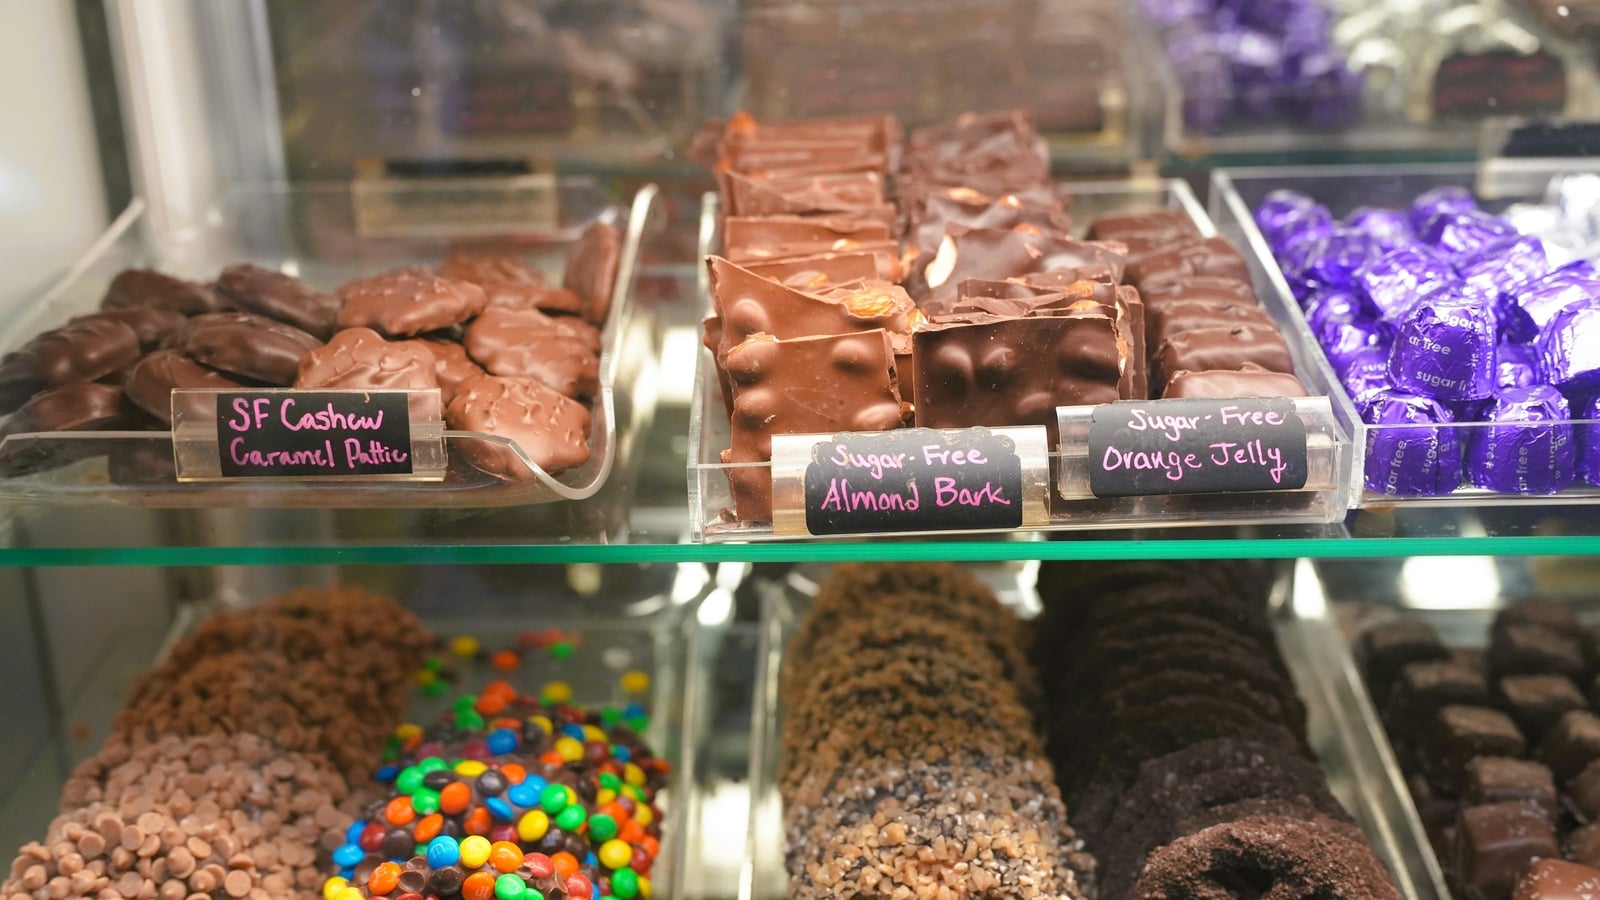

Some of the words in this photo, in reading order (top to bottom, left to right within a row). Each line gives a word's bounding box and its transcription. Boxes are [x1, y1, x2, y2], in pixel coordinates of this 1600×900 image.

[1416, 371, 1457, 389] sugar
[228, 397, 271, 432] SF
[280, 398, 384, 432] Cashew
[229, 436, 336, 468] Caramel
[1102, 445, 1202, 481] Orange
[1208, 439, 1288, 484] Jelly
[1390, 440, 1408, 468] free
[1516, 446, 1528, 474] free
[820, 478, 920, 513] Almond
[934, 476, 1011, 508] Bark
[1385, 470, 1399, 496] gar
